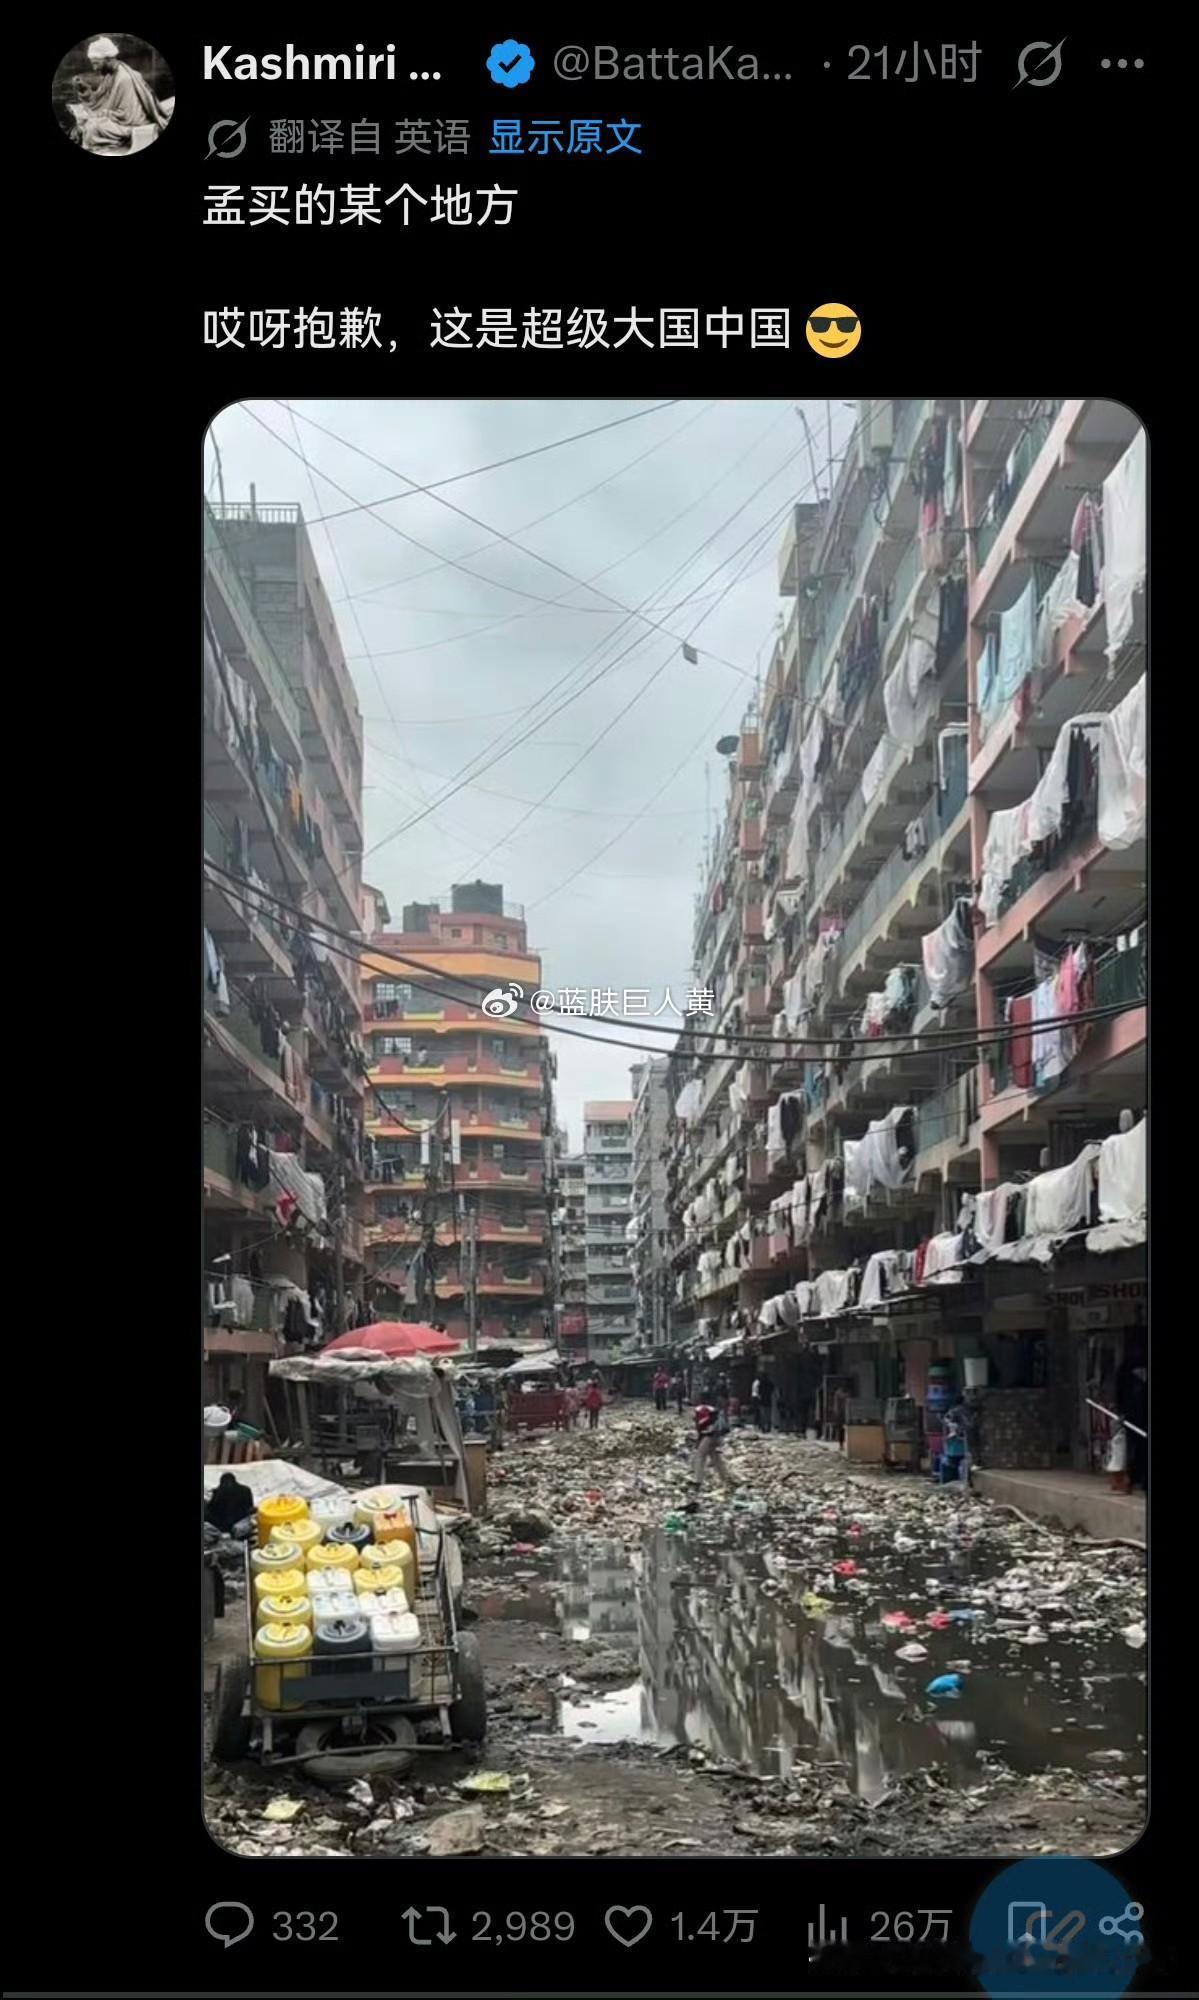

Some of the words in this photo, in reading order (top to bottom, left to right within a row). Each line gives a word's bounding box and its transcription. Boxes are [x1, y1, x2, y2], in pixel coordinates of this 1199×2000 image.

[203, 44, 396, 81] Kashmiri
[847, 39, 983, 83] 21小时
[268, 117, 380, 155] 翻译自
[394, 117, 471, 155] 英语
[488, 117, 643, 155] 显示原文
[202, 182, 519, 227] 孟买的某个地方
[203, 305, 793, 353] 哎呀抱歉，这是超级大国中国
[272, 1910, 339, 1942] 332
[471, 1910, 575, 1946] 2,989
[671, 1909, 759, 1944] 1.4万
[870, 1909, 953, 1944] 26万
